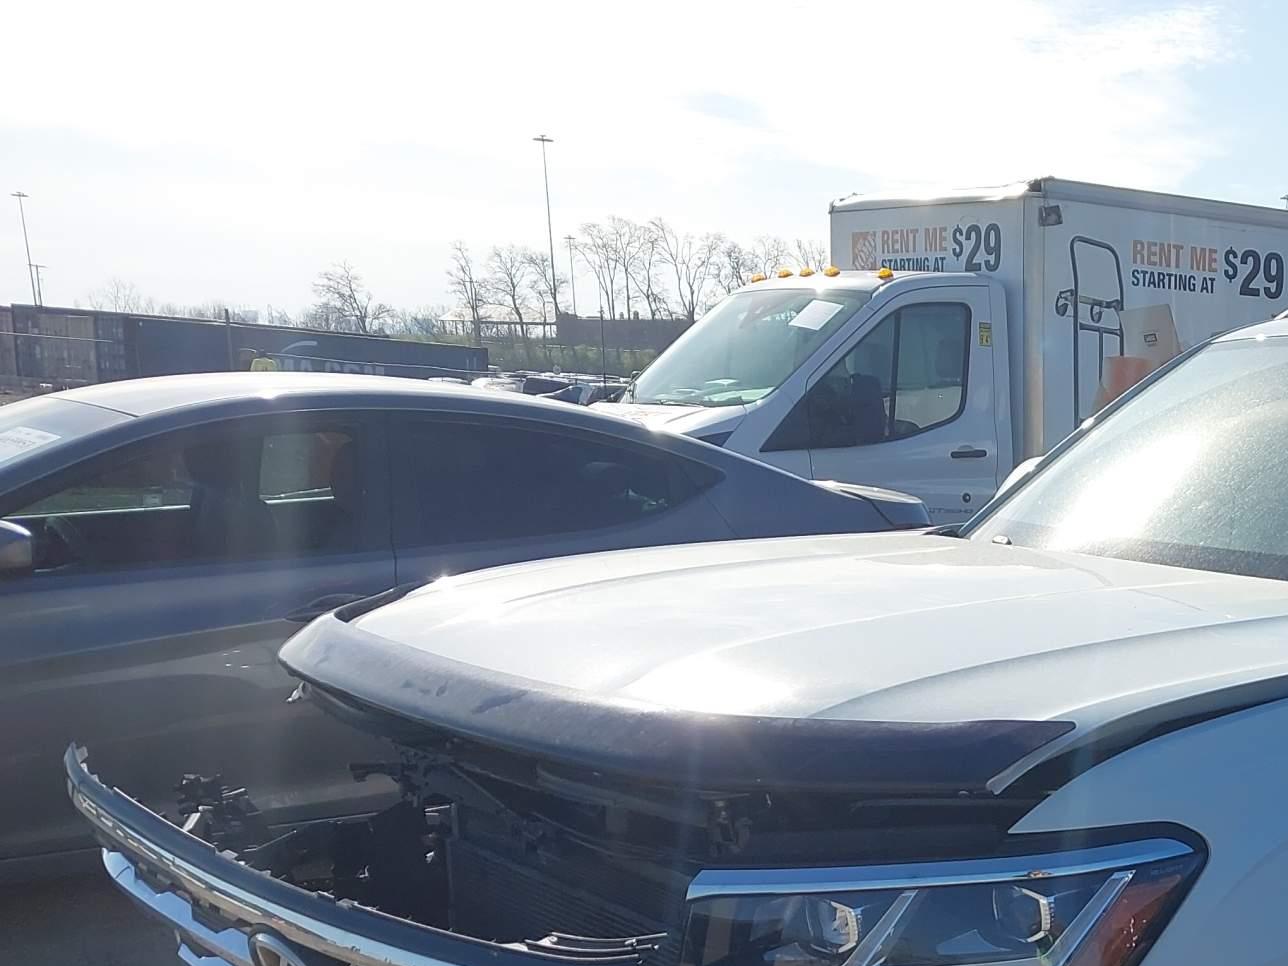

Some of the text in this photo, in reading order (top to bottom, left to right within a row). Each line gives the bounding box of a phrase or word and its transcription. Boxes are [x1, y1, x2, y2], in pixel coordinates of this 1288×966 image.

[881, 228, 919, 254] RENT
[924, 226, 948, 253] ME
[952, 223, 1001, 272] $29
[932, 256, 946, 272] AT
[1131, 240, 1218, 273] RENT ME
[1131, 269, 1216, 294] STARTING AT
[1223, 246, 1285, 300] $29
